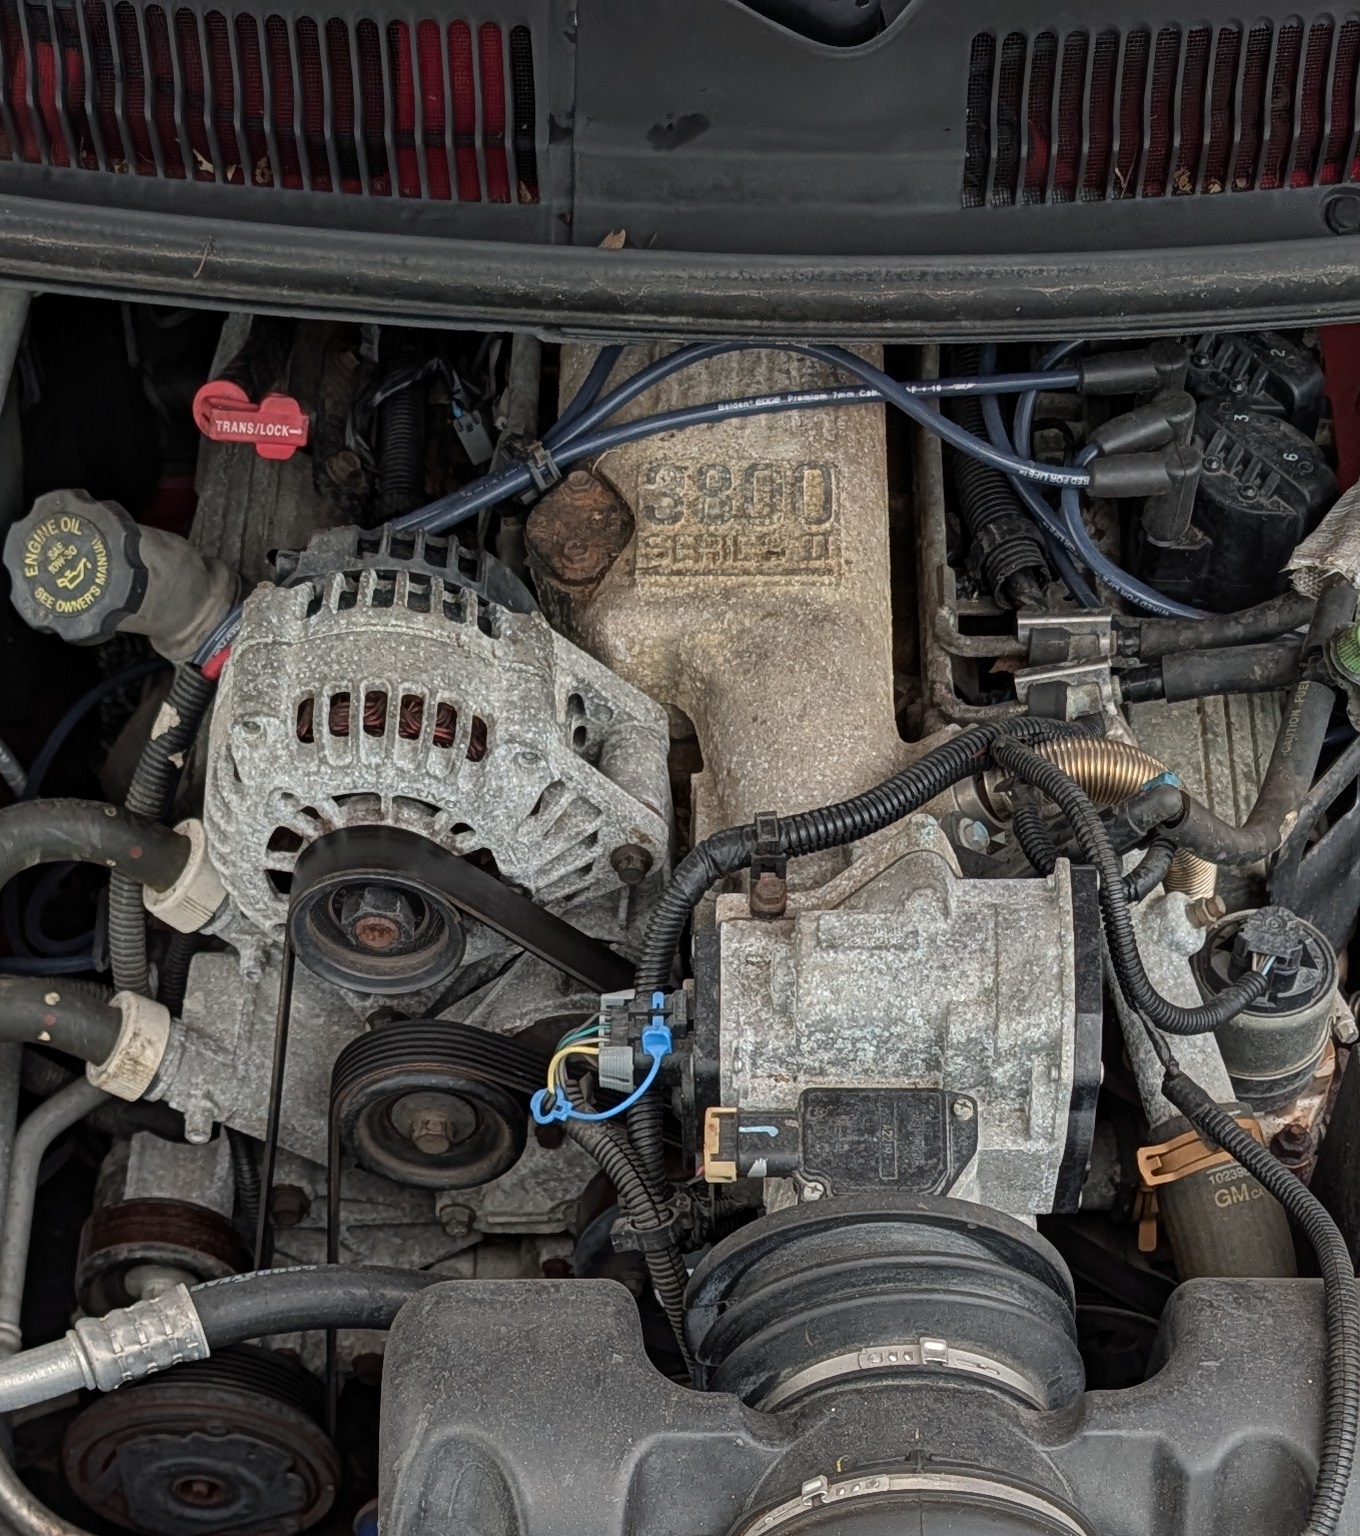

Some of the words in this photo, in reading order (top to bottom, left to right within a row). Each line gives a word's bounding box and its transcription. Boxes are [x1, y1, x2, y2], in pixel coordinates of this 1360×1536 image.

[1270, 349, 1285, 357] 2
[216, 420, 289, 436] TRANS/LOCK
[1234, 414, 1249, 422] 3
[1051, 476, 1069, 484] FOR
[641, 463, 834, 526] 3800
[24, 519, 59, 577] ENGINE
[61, 516, 81, 535] OIL
[47, 542, 65, 560] SAE
[48, 545, 78, 574] 10W-30
[35, 587, 55, 609] SEE
[56, 585, 101, 613] OWNER'S
[91, 534, 108, 585] MANUAL
[1281, 709, 1301, 756] CAUTION
[1215, 1183, 1250, 1207] GM
